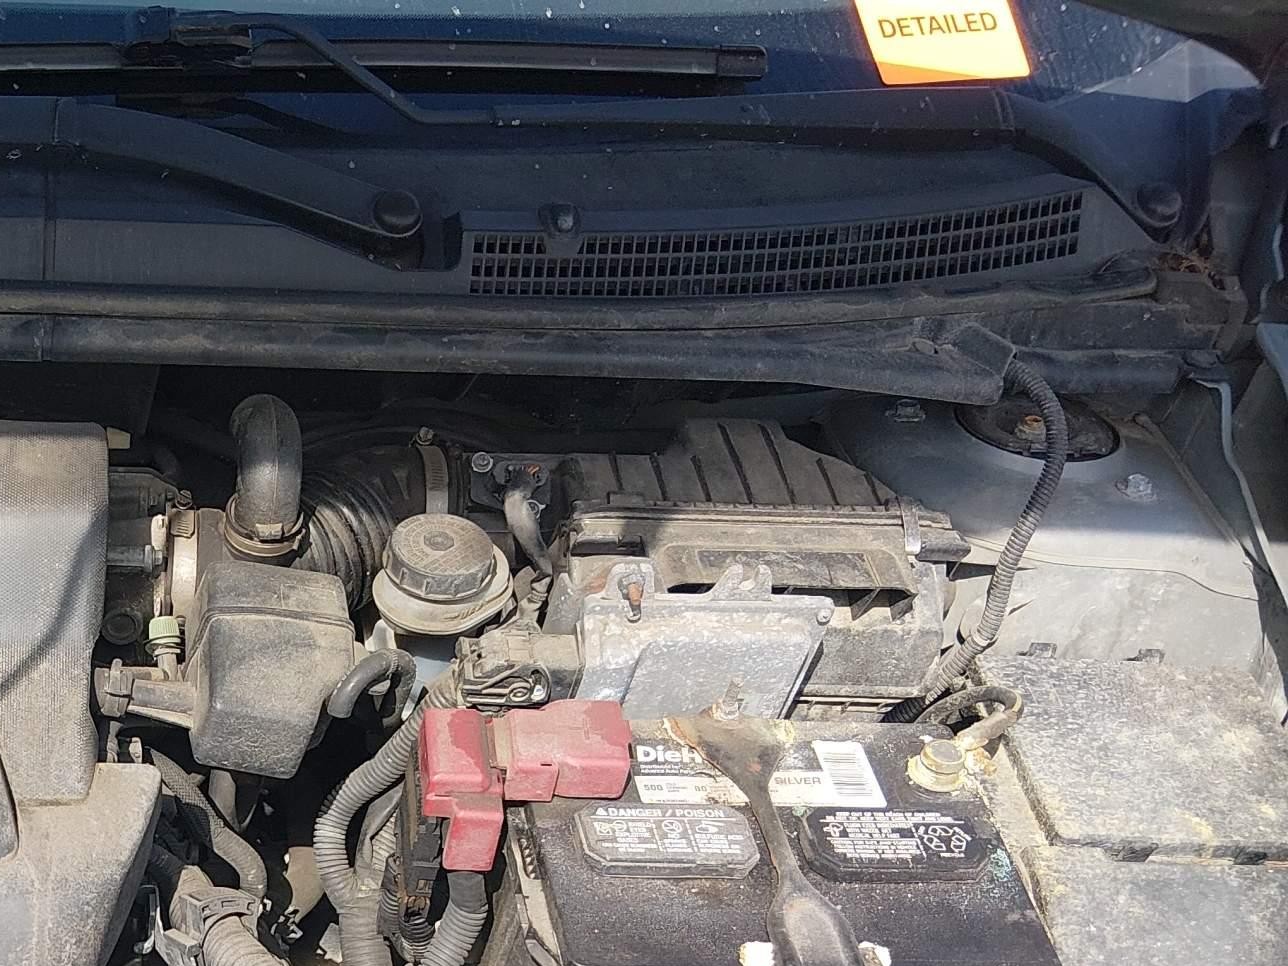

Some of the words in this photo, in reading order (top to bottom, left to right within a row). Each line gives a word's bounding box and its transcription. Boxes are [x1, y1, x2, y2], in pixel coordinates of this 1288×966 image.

[877, 12, 998, 38] DETAILED
[636, 744, 703, 764] DieH
[774, 776, 822, 785] SILVER
[608, 807, 661, 817] DANGER
[675, 808, 725, 818] POISON
